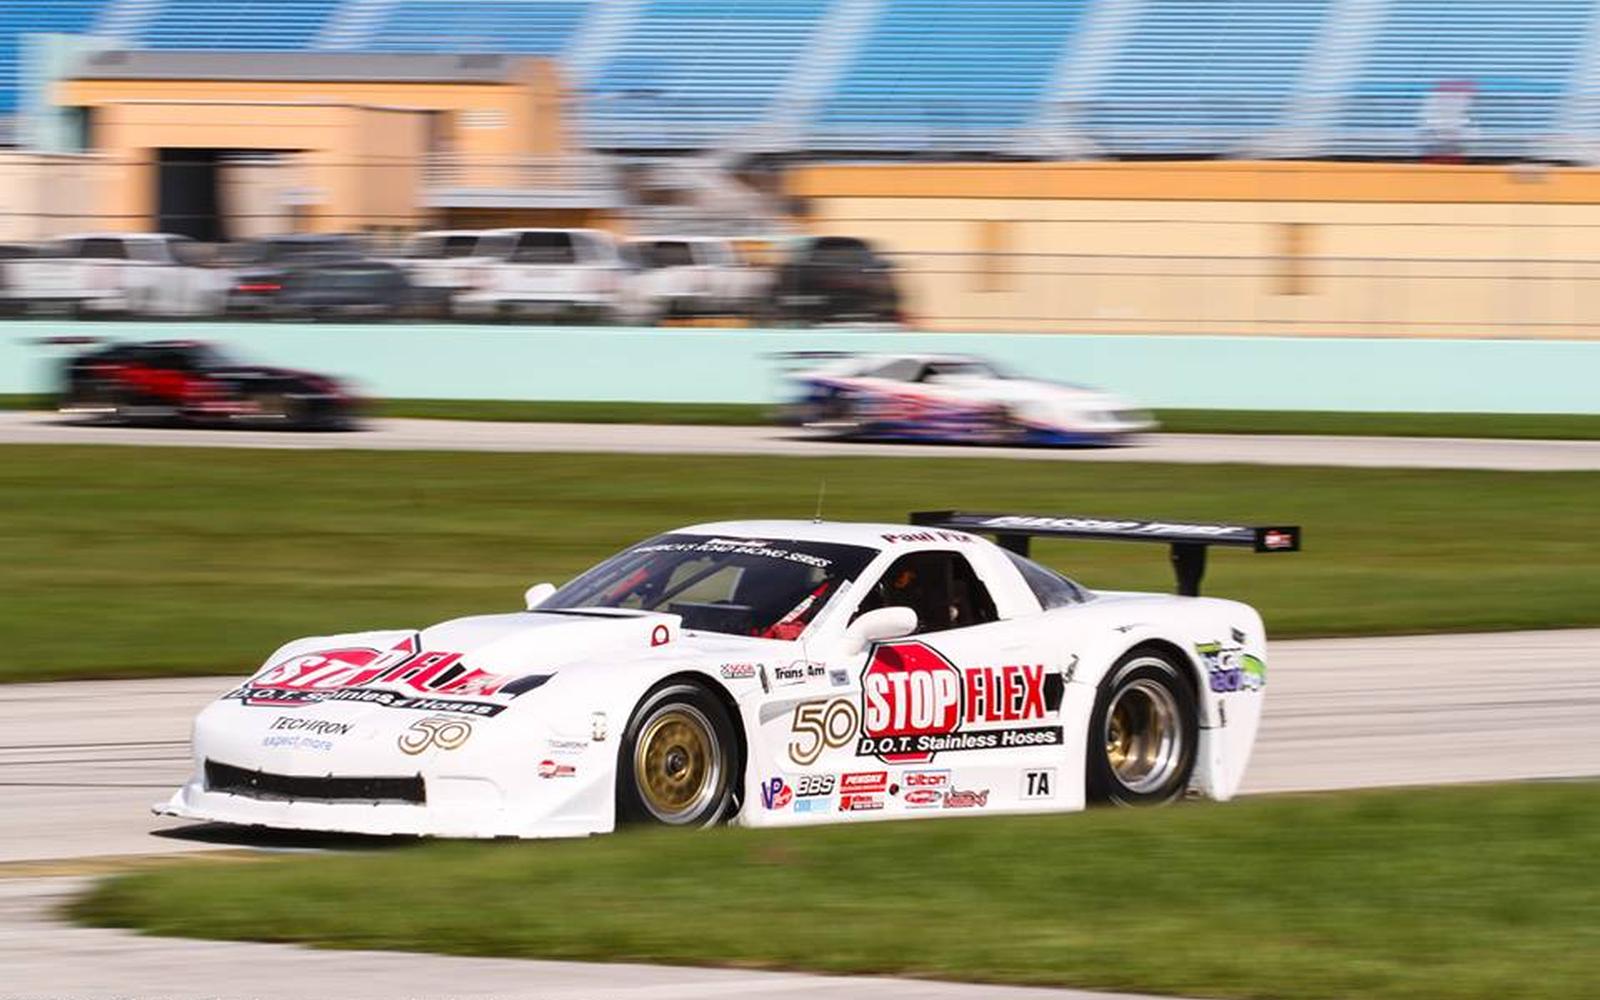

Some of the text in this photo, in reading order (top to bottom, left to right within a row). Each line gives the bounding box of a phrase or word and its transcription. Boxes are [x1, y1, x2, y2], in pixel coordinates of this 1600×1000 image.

[775, 664, 826, 680] Trans Am
[865, 669, 958, 732] STOP
[965, 664, 1045, 724] FLEX
[269, 715, 354, 736] TECHRON
[397, 717, 473, 756] 50
[788, 698, 859, 766] 50
[860, 730, 1057, 755] D.O.T. Stainless Hoses
[795, 775, 836, 798] BBS
[905, 774, 947, 786] tilton
[1027, 772, 1050, 796] TA
[761, 777, 784, 810] VP
